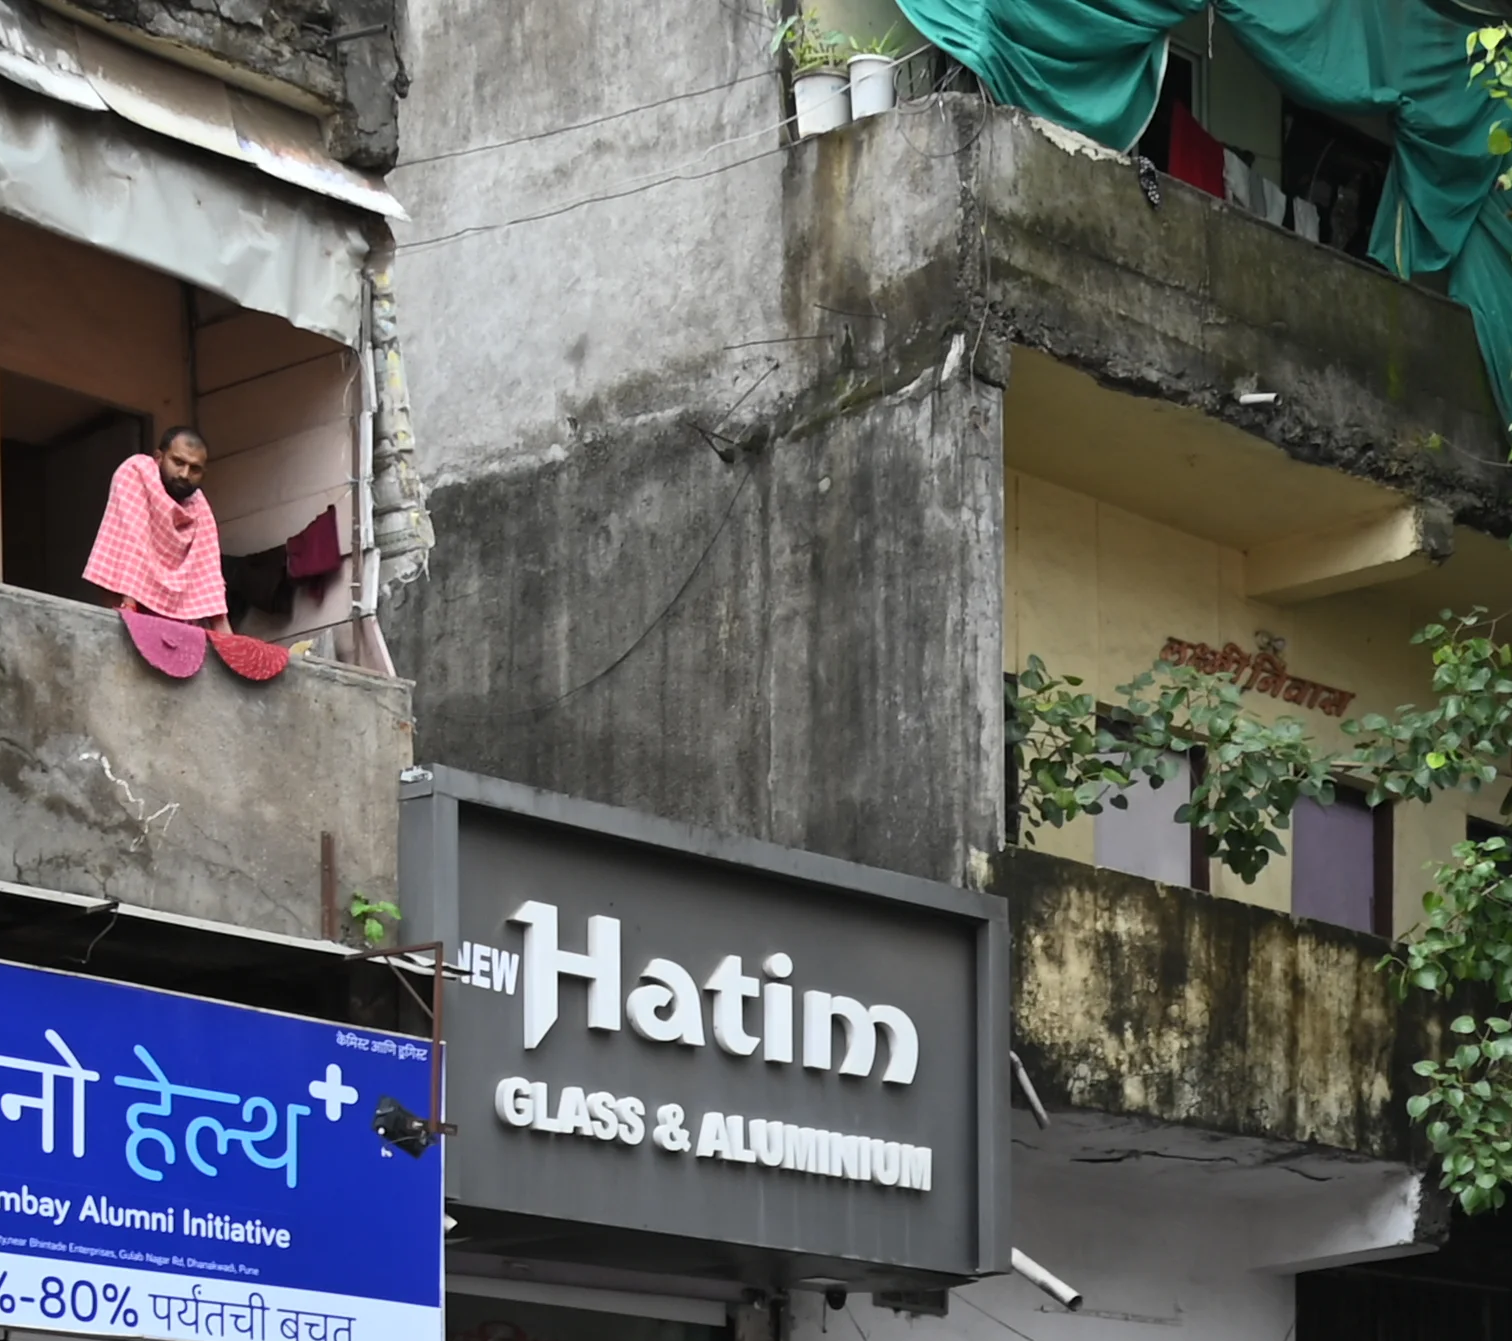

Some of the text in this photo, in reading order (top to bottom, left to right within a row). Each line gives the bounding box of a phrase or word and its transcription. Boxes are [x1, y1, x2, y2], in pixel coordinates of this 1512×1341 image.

[505, 899, 919, 1085] Hatim
[114, 1044, 311, 1188] हेल्थ
[495, 1076, 932, 1192] GLASS & ALUMINIUM
[80, 1195, 174, 1232] Alumni
[184, 1208, 290, 1248] Initiative
[148, 1284, 269, 1341] पर्यंतची
